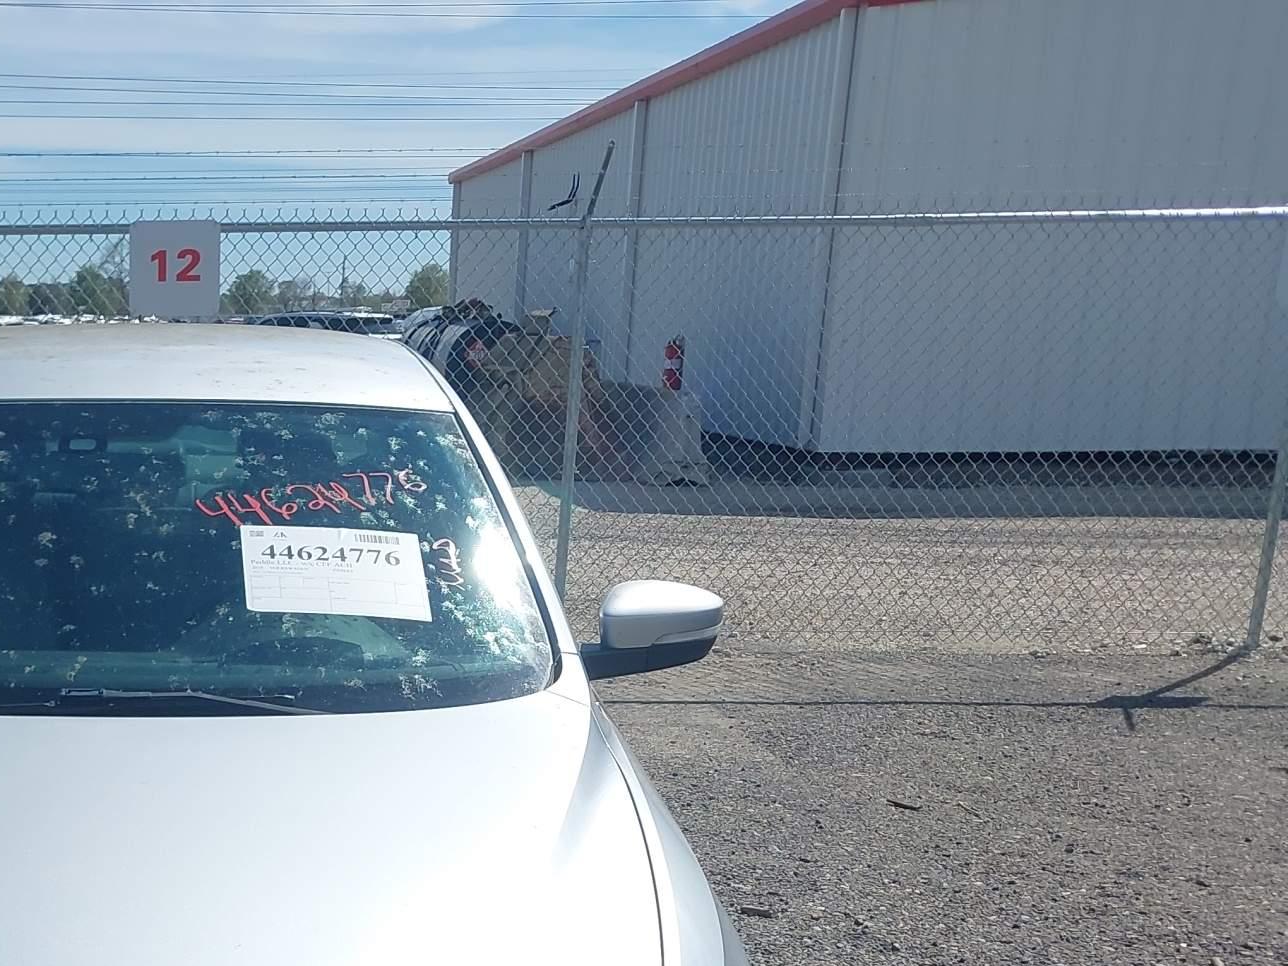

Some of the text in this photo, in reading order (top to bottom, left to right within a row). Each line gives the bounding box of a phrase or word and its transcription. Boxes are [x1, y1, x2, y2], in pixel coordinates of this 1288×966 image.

[150, 249, 201, 282] 12
[196, 468, 428, 527] 44624776
[261, 544, 401, 567] 44624776
